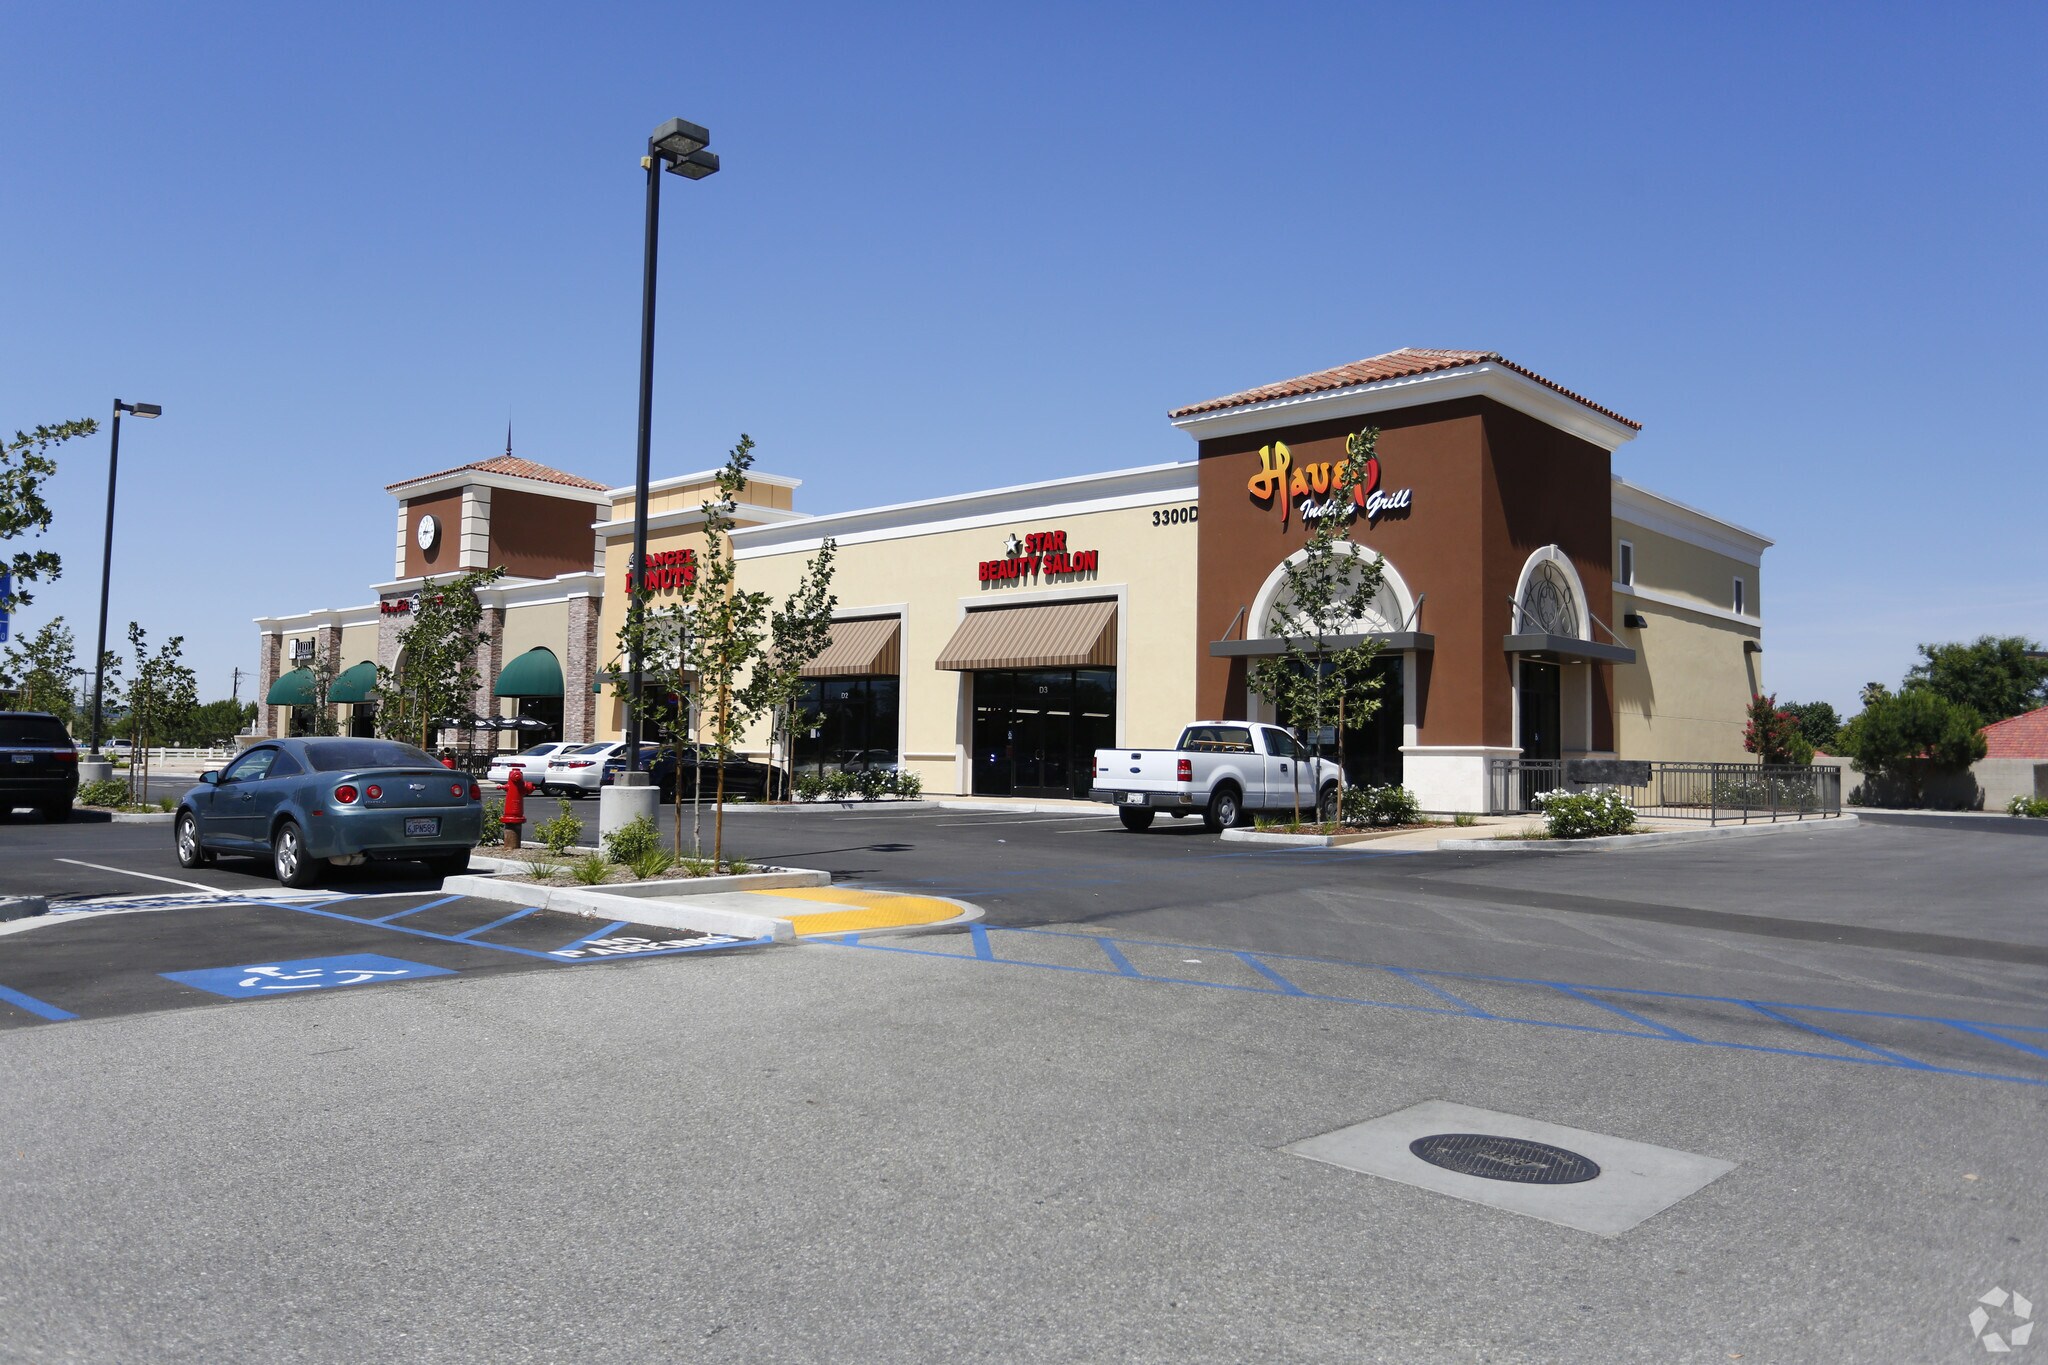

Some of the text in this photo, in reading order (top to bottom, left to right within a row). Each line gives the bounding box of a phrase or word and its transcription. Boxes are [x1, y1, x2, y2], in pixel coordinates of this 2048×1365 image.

[1366, 489, 1410, 518] Grill
[1024, 530, 1066, 553] STAR
[979, 550, 1098, 581] BEAUTY SALON
[1039, 686, 1048, 694] D3
[548, 936, 739, 958] PARKING
[583, 937, 652, 947] NO
